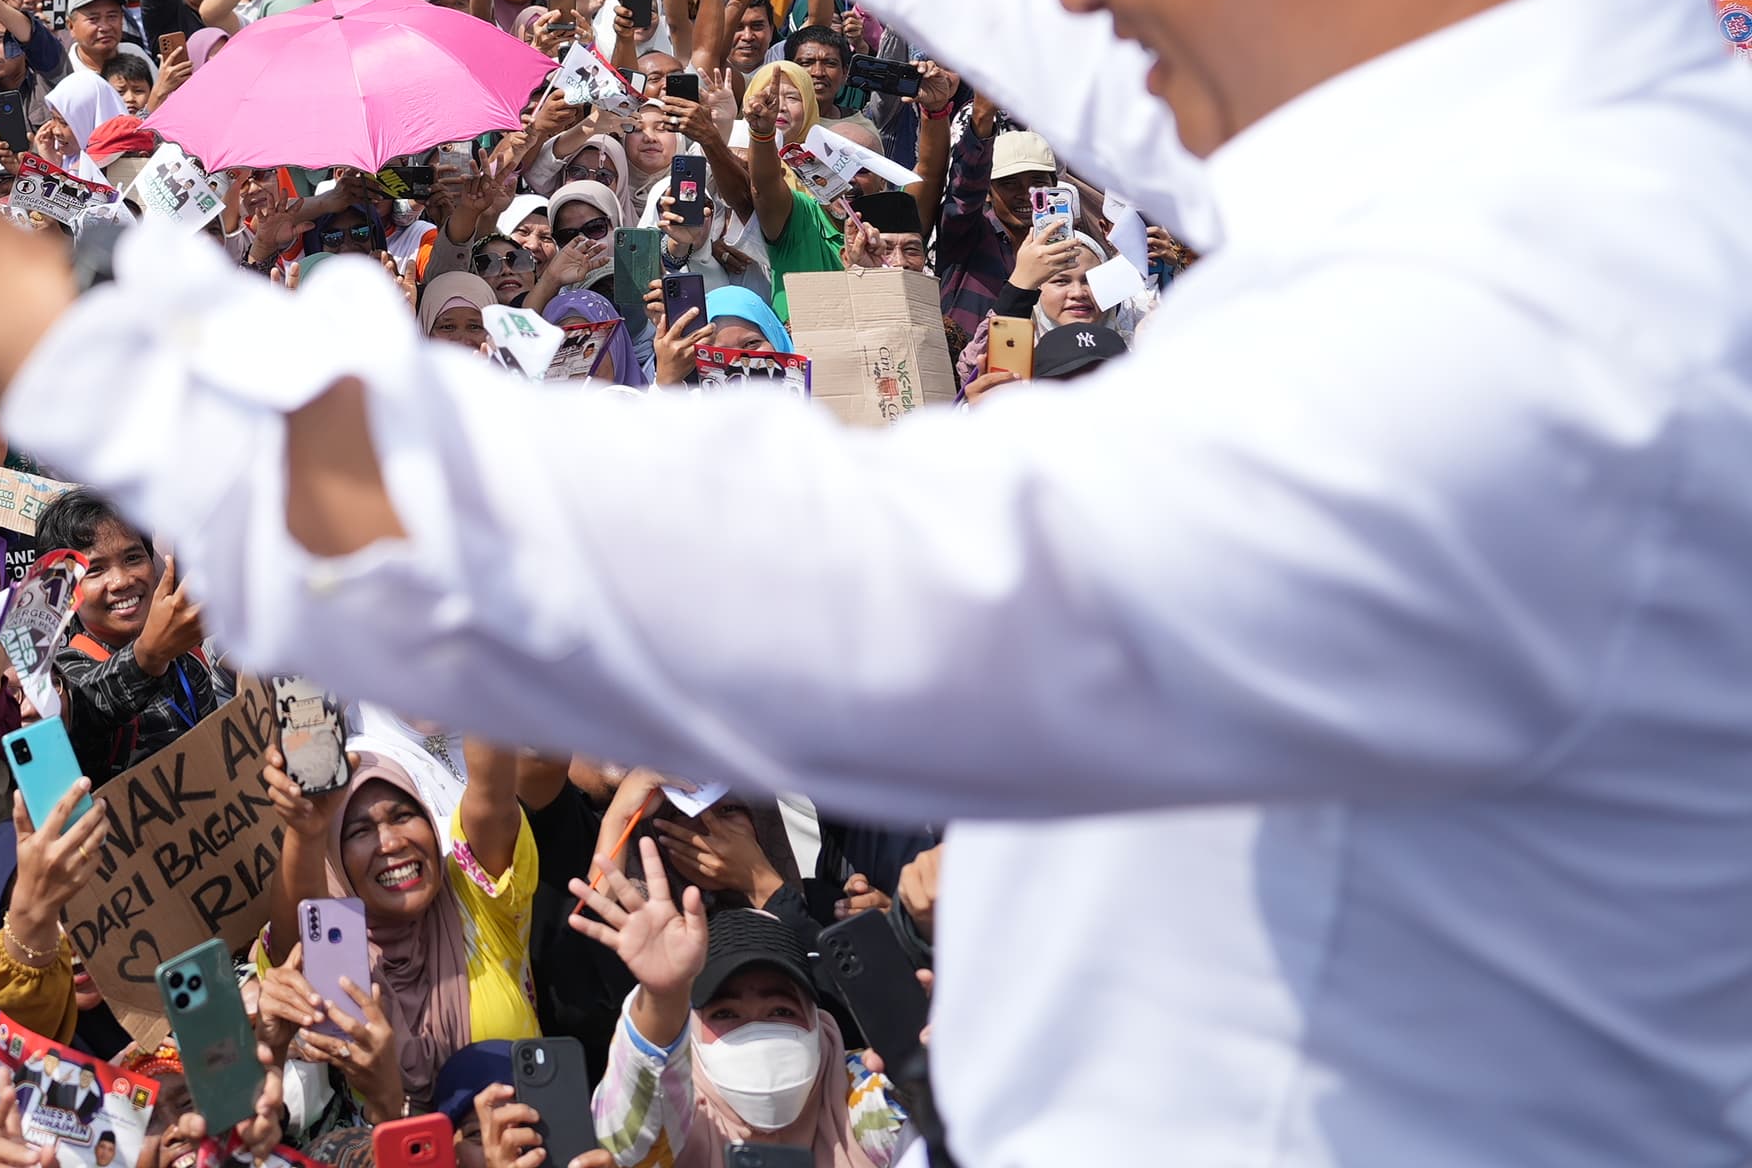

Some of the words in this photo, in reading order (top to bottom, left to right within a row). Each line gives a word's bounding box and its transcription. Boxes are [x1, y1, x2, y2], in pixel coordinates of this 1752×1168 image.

[40, 181, 57, 199] 1
[14, 194, 55, 210] BERGERAK
[45, 578, 64, 608] 1
[71, 871, 155, 960] DARI
[34, 1106, 64, 1120] ANIES
[30, 1115, 88, 1136] MUHAIMIN
